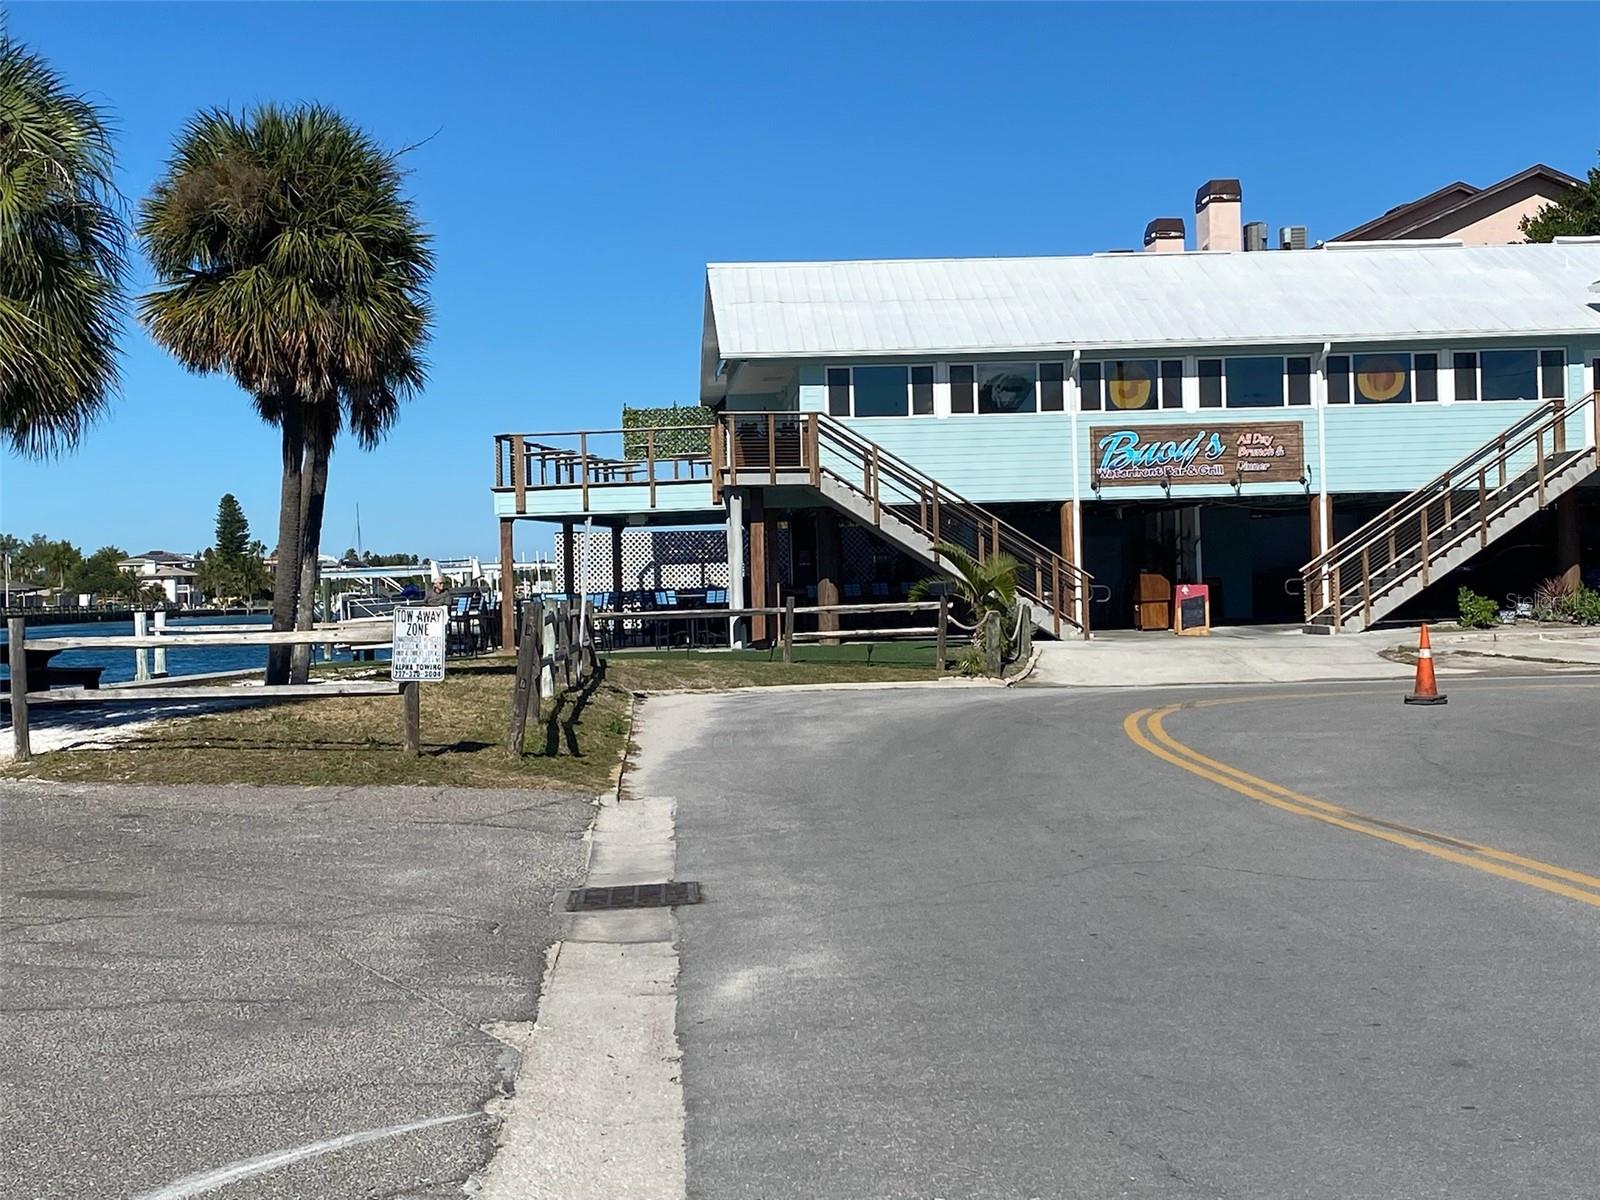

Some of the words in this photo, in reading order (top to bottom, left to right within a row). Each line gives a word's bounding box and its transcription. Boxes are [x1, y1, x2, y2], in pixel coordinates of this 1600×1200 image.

[1236, 433, 1252, 445] All
[1252, 433, 1274, 446] Day
[1098, 430, 1226, 470] Buoy's
[1237, 445, 1275, 457] Brunch
[1275, 445, 1285, 457] &
[1096, 466, 1163, 479] Waterfront
[1165, 465, 1185, 477] Bar
[1187, 465, 1197, 476] &
[1199, 463, 1225, 476] Grill
[397, 609, 413, 623] TOW
[416, 610, 442, 623] AWAY
[406, 623, 430, 636] ZONE
